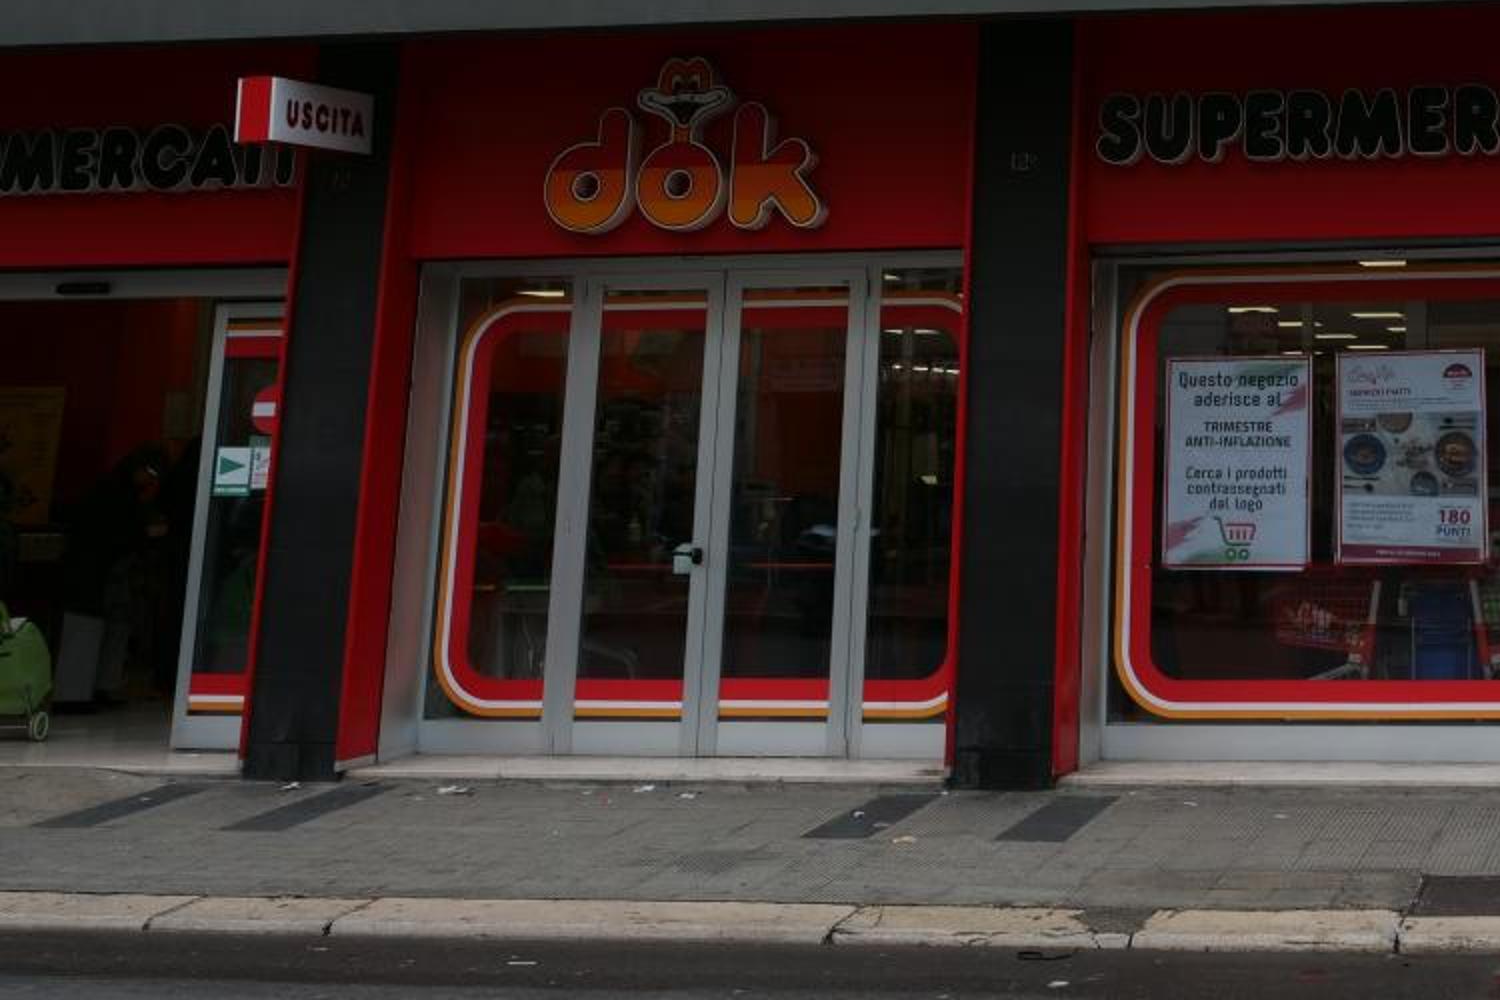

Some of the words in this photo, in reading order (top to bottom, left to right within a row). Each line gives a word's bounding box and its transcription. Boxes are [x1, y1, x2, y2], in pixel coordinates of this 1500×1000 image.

[286, 99, 365, 138] USCITA
[543, 100, 830, 235] dok
[1179, 371, 1233, 389] Questo
[1238, 373, 1299, 390] negozio
[1193, 391, 1261, 407] aderisce
[1267, 391, 1282, 407] al
[1203, 421, 1274, 433] TRIMESTRE
[1185, 435, 1292, 448] ANTI-INFLAZIONE
[1185, 466, 1223, 480] Cerca
[1235, 466, 1287, 482] prodotti
[1187, 482, 1286, 498] contrassegnati
[1209, 497, 1230, 511] dal
[1235, 497, 1263, 513] logo
[1439, 508, 1472, 524] 180
[1437, 526, 1473, 538] PUNTI
